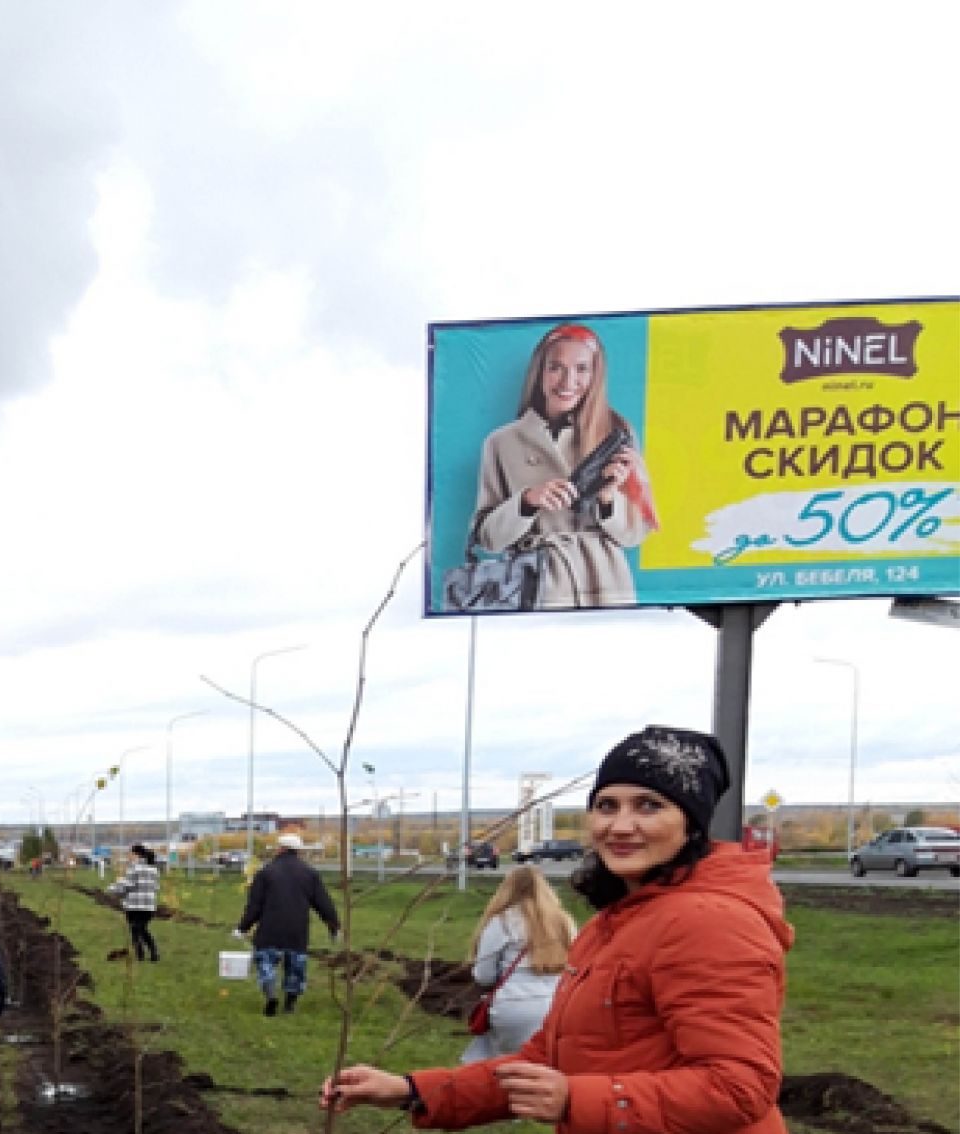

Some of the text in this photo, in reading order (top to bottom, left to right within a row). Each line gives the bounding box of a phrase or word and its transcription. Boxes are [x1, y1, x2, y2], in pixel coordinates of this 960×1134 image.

[794, 333, 908, 368] NiNEL
[724, 400, 960, 442] МАРАФОН
[743, 439, 945, 480] СКИДОК
[782, 487, 955, 546] 50%
[886, 565, 920, 582] 124
